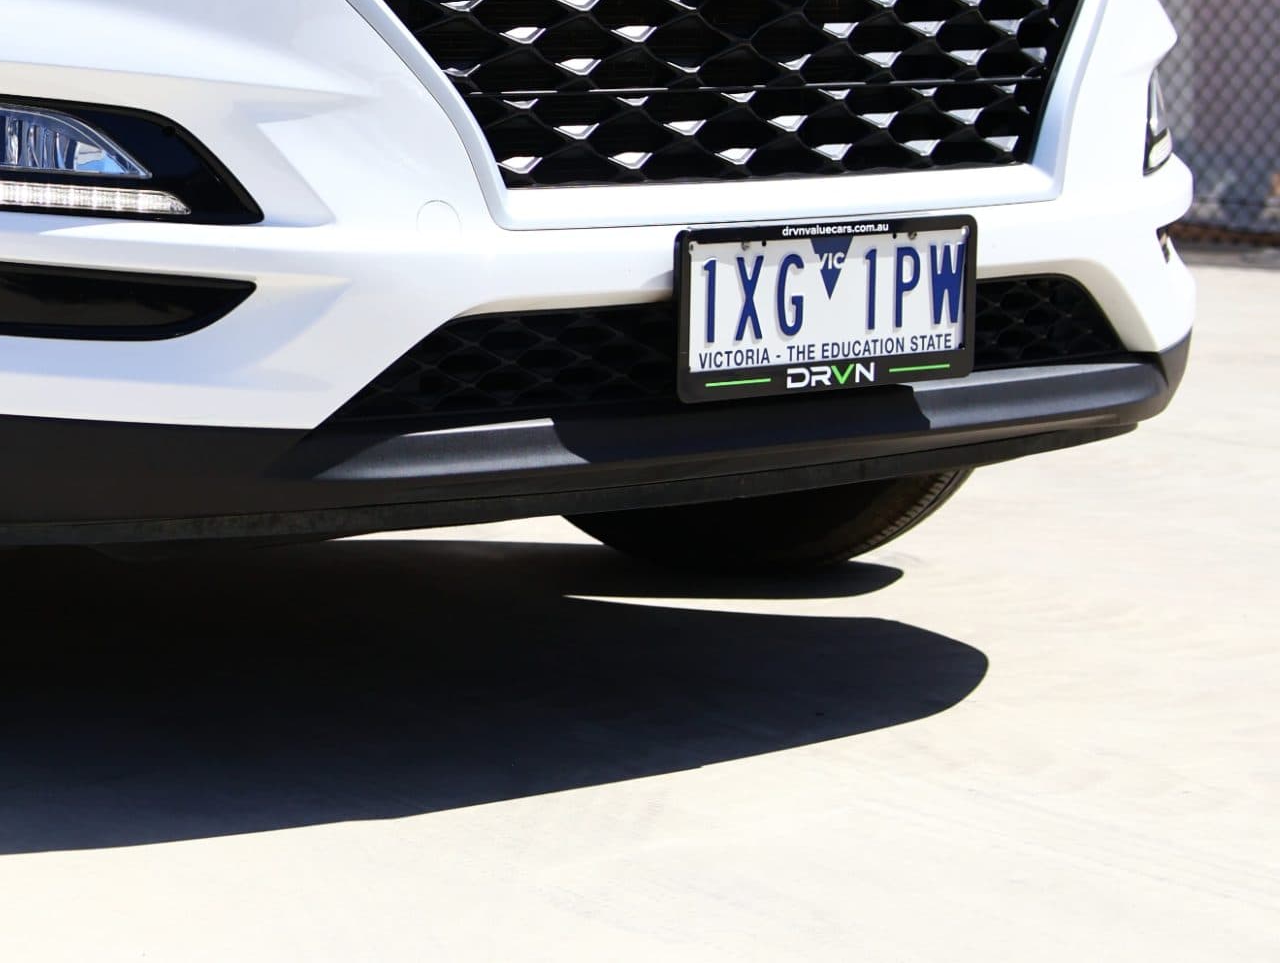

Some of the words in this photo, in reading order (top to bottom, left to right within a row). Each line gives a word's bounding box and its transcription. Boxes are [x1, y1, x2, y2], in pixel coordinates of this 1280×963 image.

[781, 223, 889, 236] drvnvaluecars.com.au
[815, 251, 846, 269] VIC
[703, 253, 805, 343] 1XG
[865, 243, 965, 330] 1PW
[698, 347, 771, 369] VICTORIA
[786, 344, 816, 362] THE
[821, 337, 905, 359] EDUCATION
[910, 334, 952, 352] STATE
[786, 362, 875, 389] DRVN
